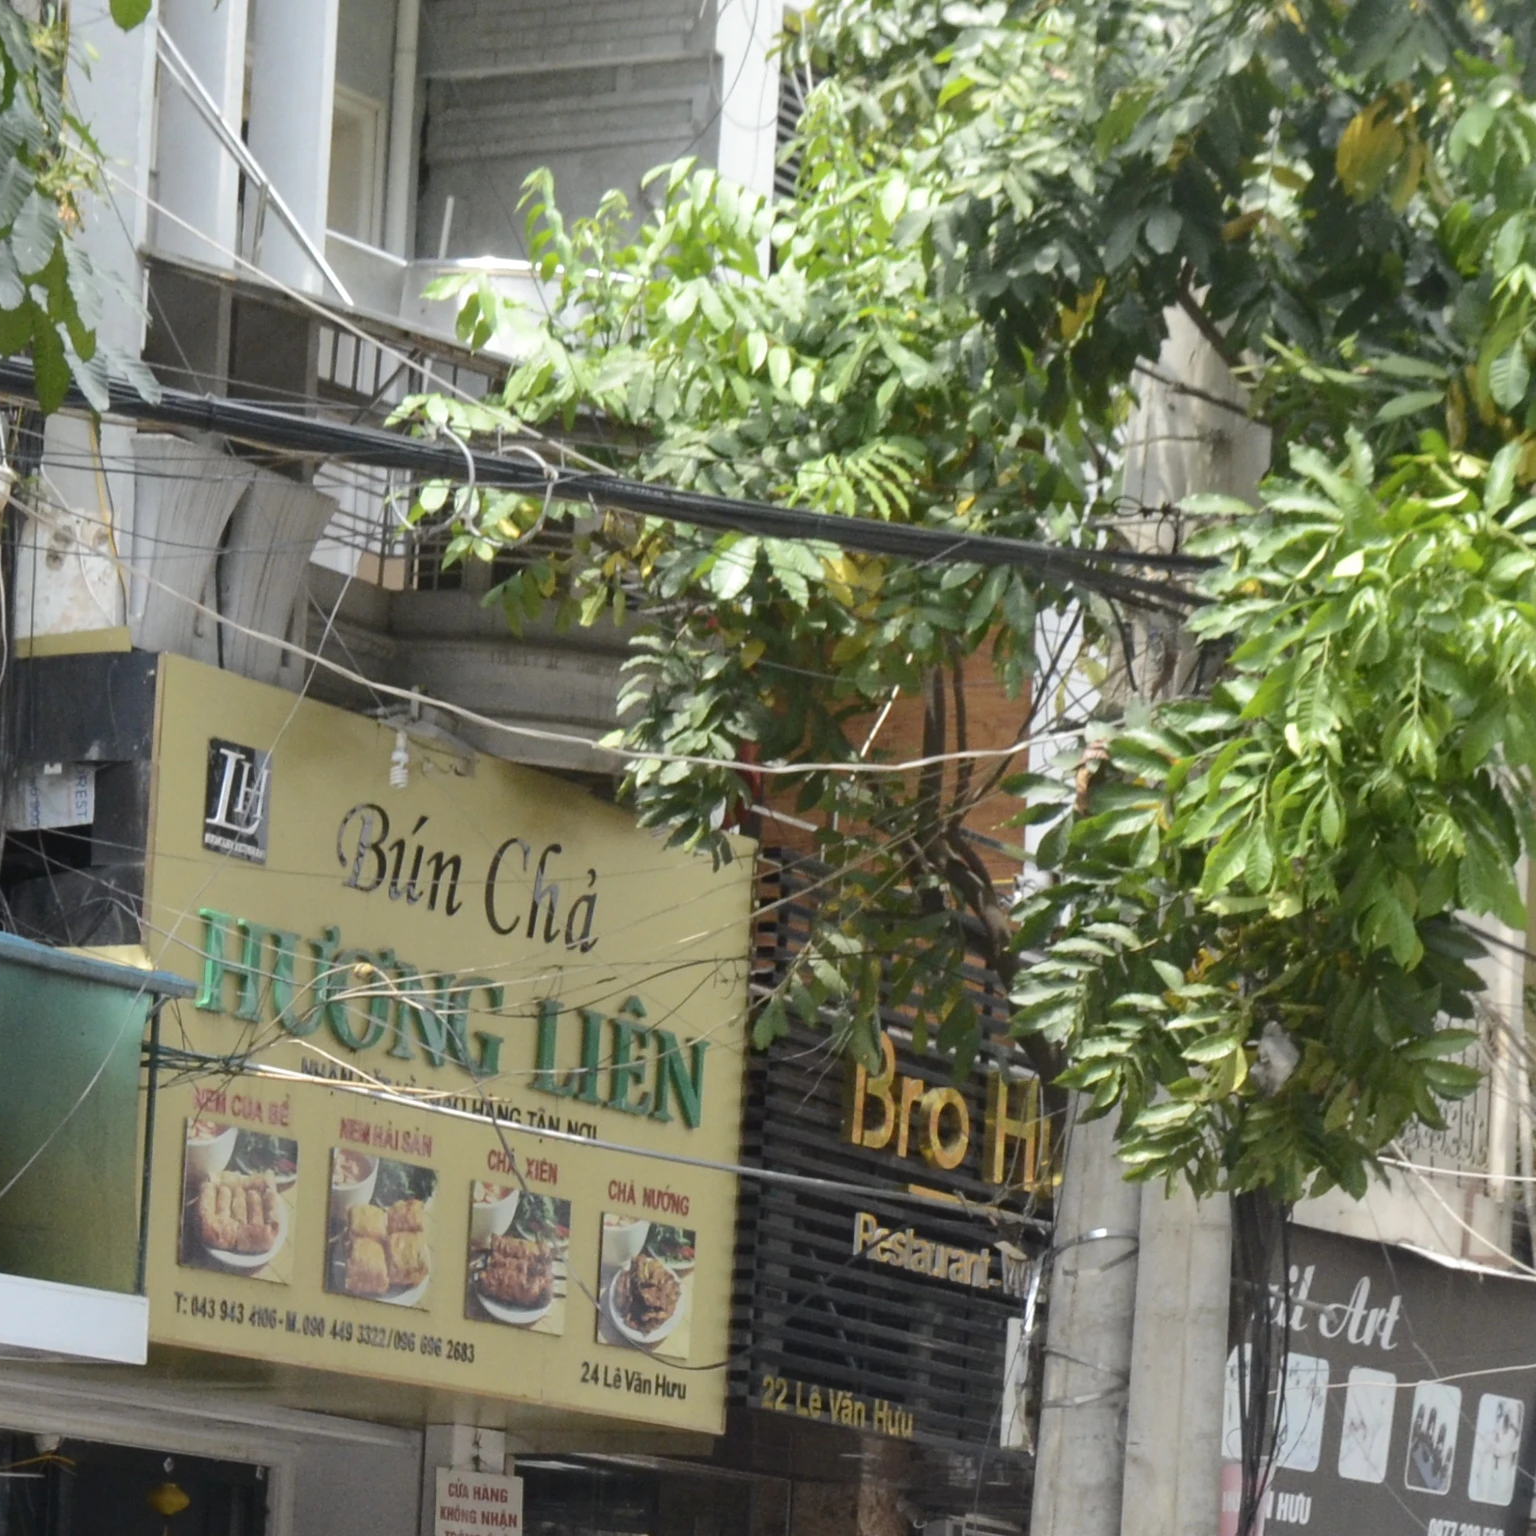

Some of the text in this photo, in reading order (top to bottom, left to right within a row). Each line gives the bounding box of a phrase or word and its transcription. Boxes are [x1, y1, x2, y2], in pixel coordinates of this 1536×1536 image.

[336, 804, 601, 954] Bún Chả
[195, 906, 712, 1130] HƯƠNG LIÊN
[193, 1087, 227, 1115] NEM
[231, 1095, 263, 1123] CUA
[339, 1117, 370, 1146] NEM
[850, 1030, 1062, 1195] Bro H
[219, 1299, 244, 1324] 943
[329, 1319, 353, 1342] 449
[445, 1339, 475, 1364] 2683
[1318, 1275, 1402, 1351] Art
[580, 1361, 687, 1400] 24 Lê Văn Hưu
[761, 1374, 788, 1412] 22
[795, 1381, 822, 1420] Lê
[828, 1388, 867, 1429] Văn
